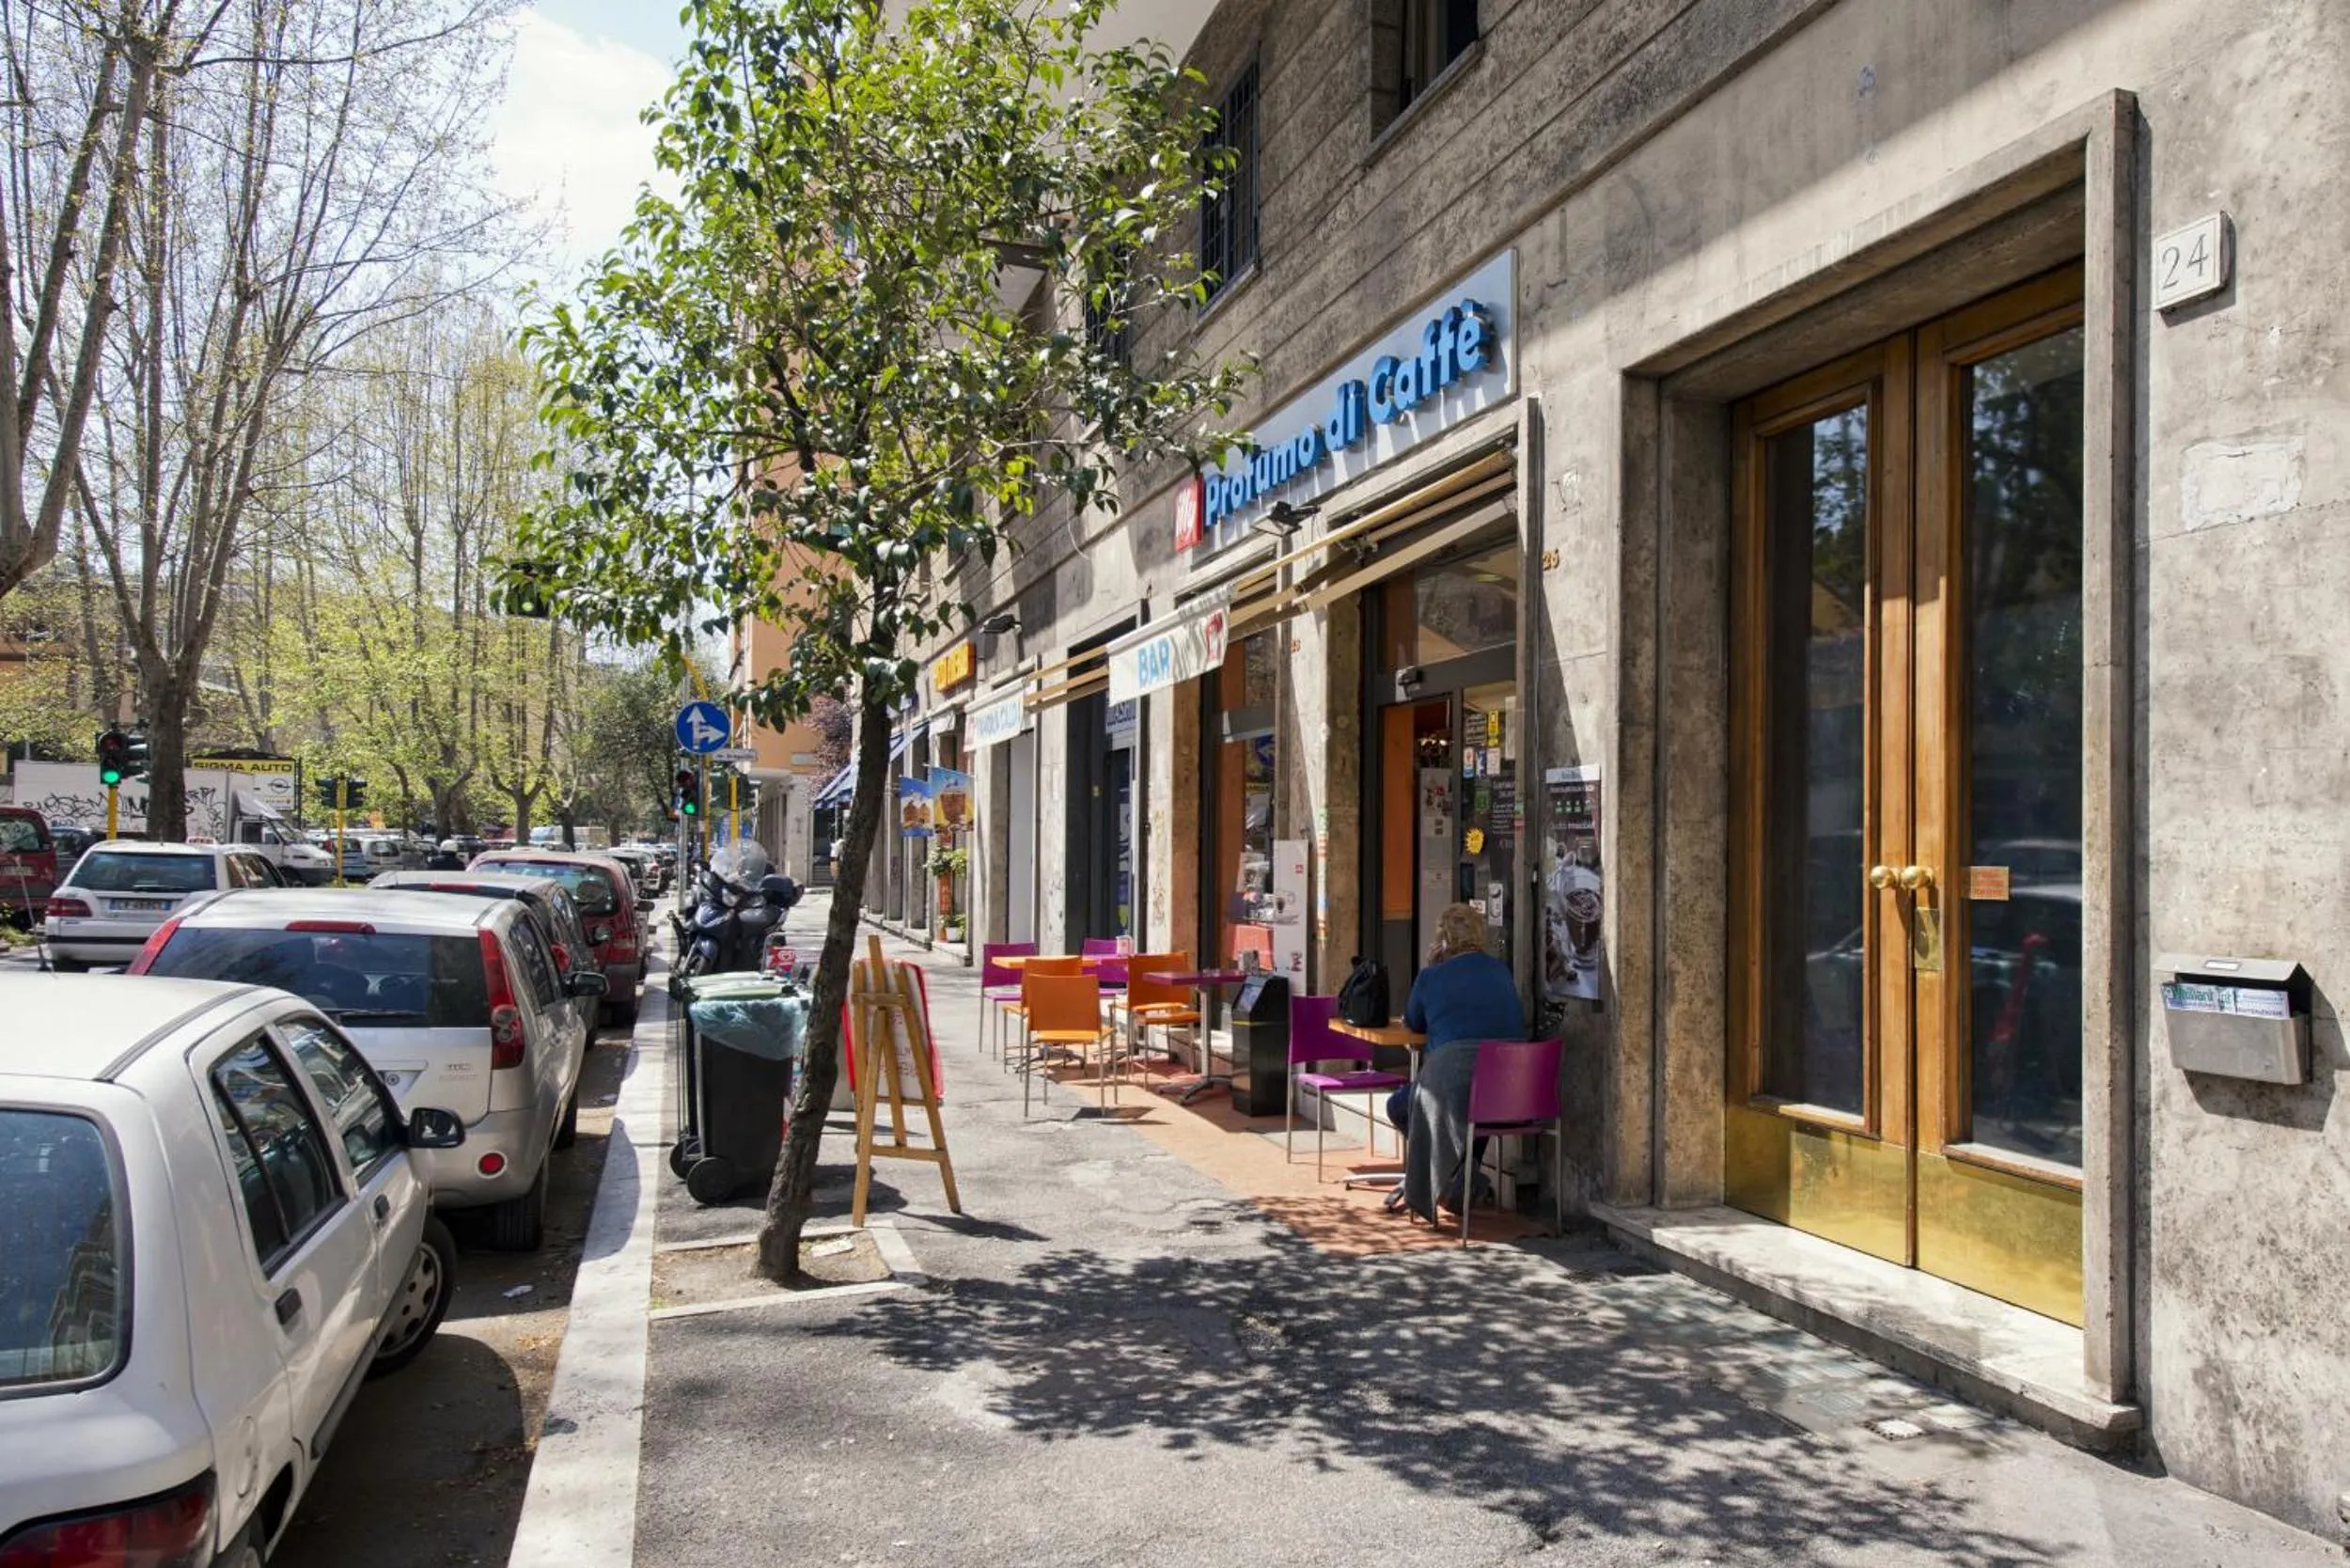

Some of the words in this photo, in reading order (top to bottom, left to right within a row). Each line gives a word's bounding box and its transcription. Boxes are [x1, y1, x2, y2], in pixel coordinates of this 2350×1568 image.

[2161, 232, 2209, 290] 24
[1205, 423, 1320, 527] Profumo
[1324, 379, 1365, 451] di
[1368, 298, 1489, 425] Caffè
[1137, 635, 1170, 687] BAR
[194, 761, 244, 772] SIGMA
[249, 762, 292, 773] AUTO
